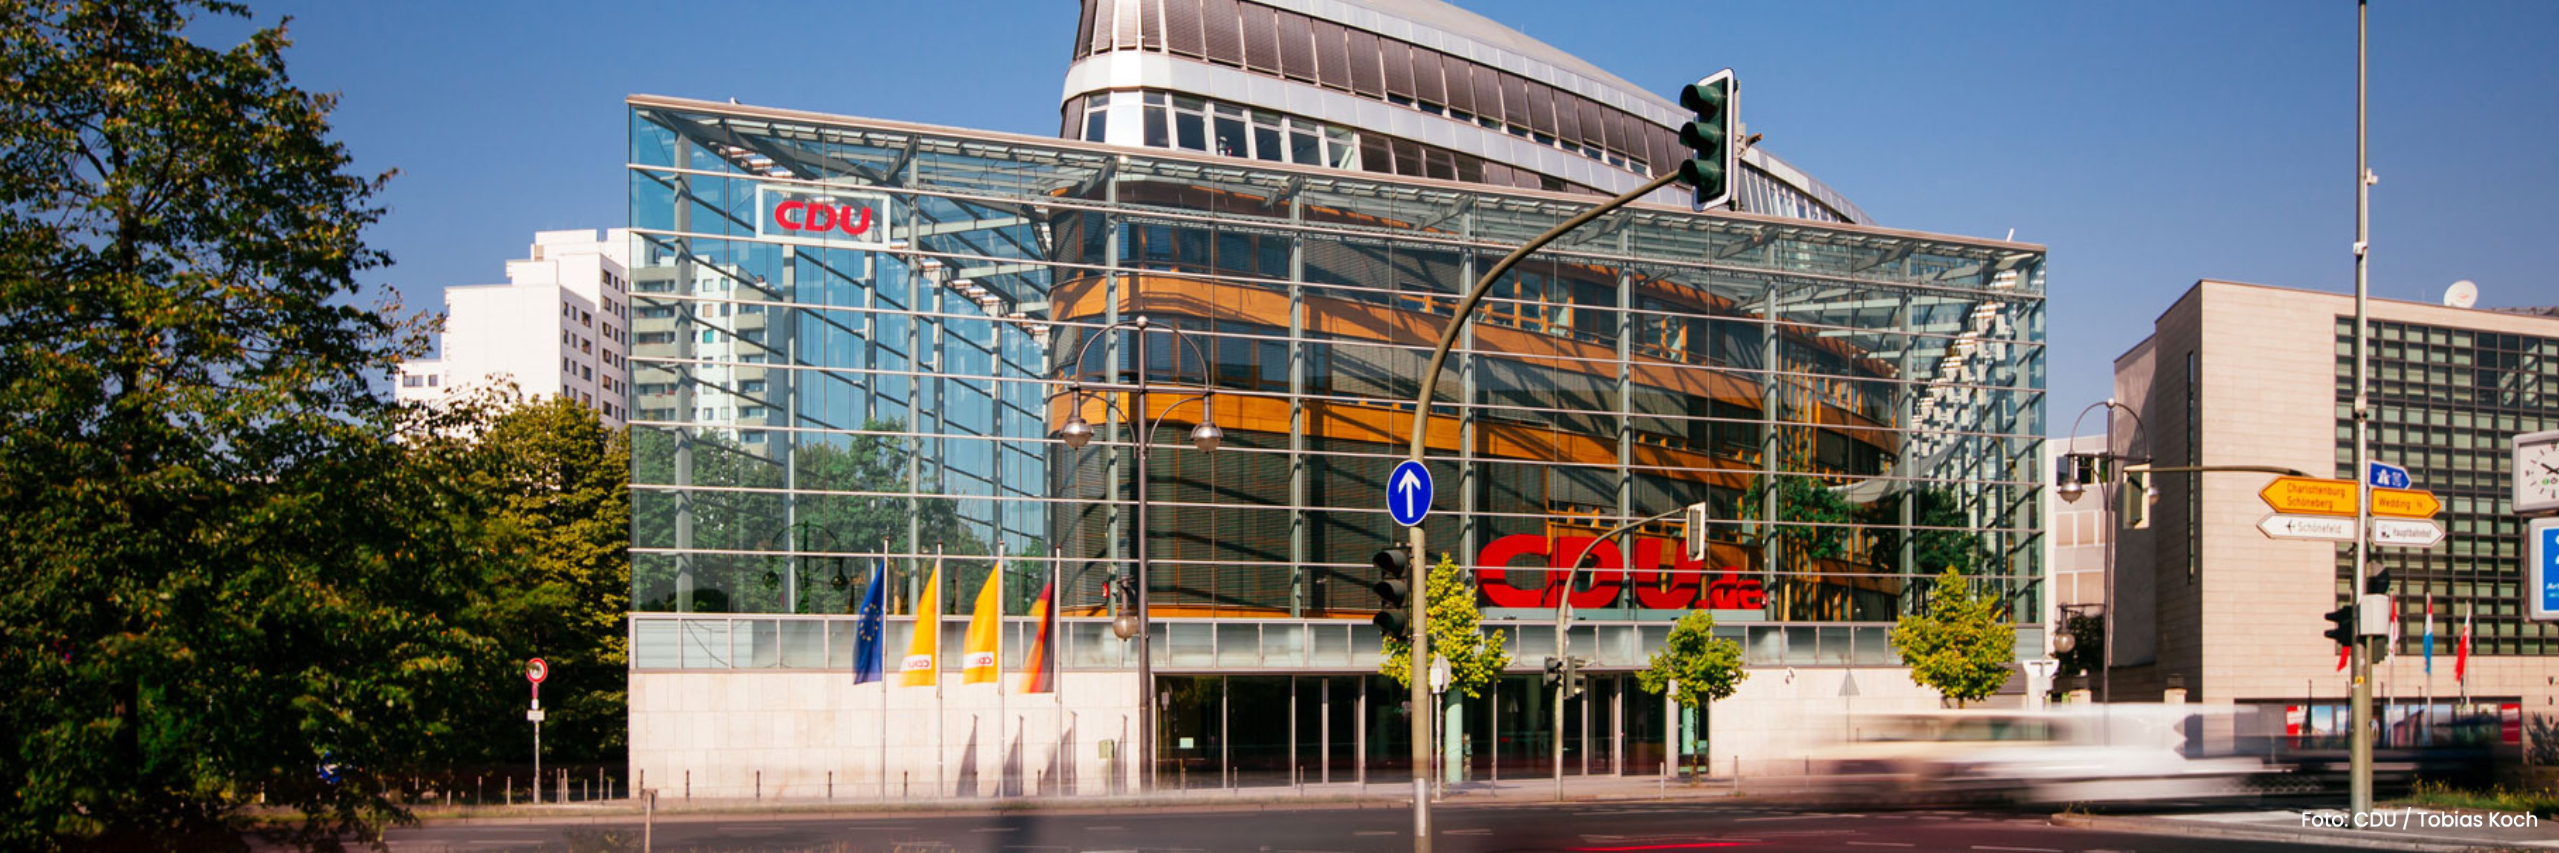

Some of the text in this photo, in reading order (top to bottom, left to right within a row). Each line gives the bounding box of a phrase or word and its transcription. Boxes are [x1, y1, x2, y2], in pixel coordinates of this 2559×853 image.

[774, 200, 873, 236] CDU
[2287, 482, 2346, 500] Charlottenburg
[2287, 495, 2333, 511] Schöneberg
[2379, 496, 2411, 511] Wedding
[2298, 521, 2341, 534] Schönefeld
[1477, 533, 1766, 609] CDU.de
